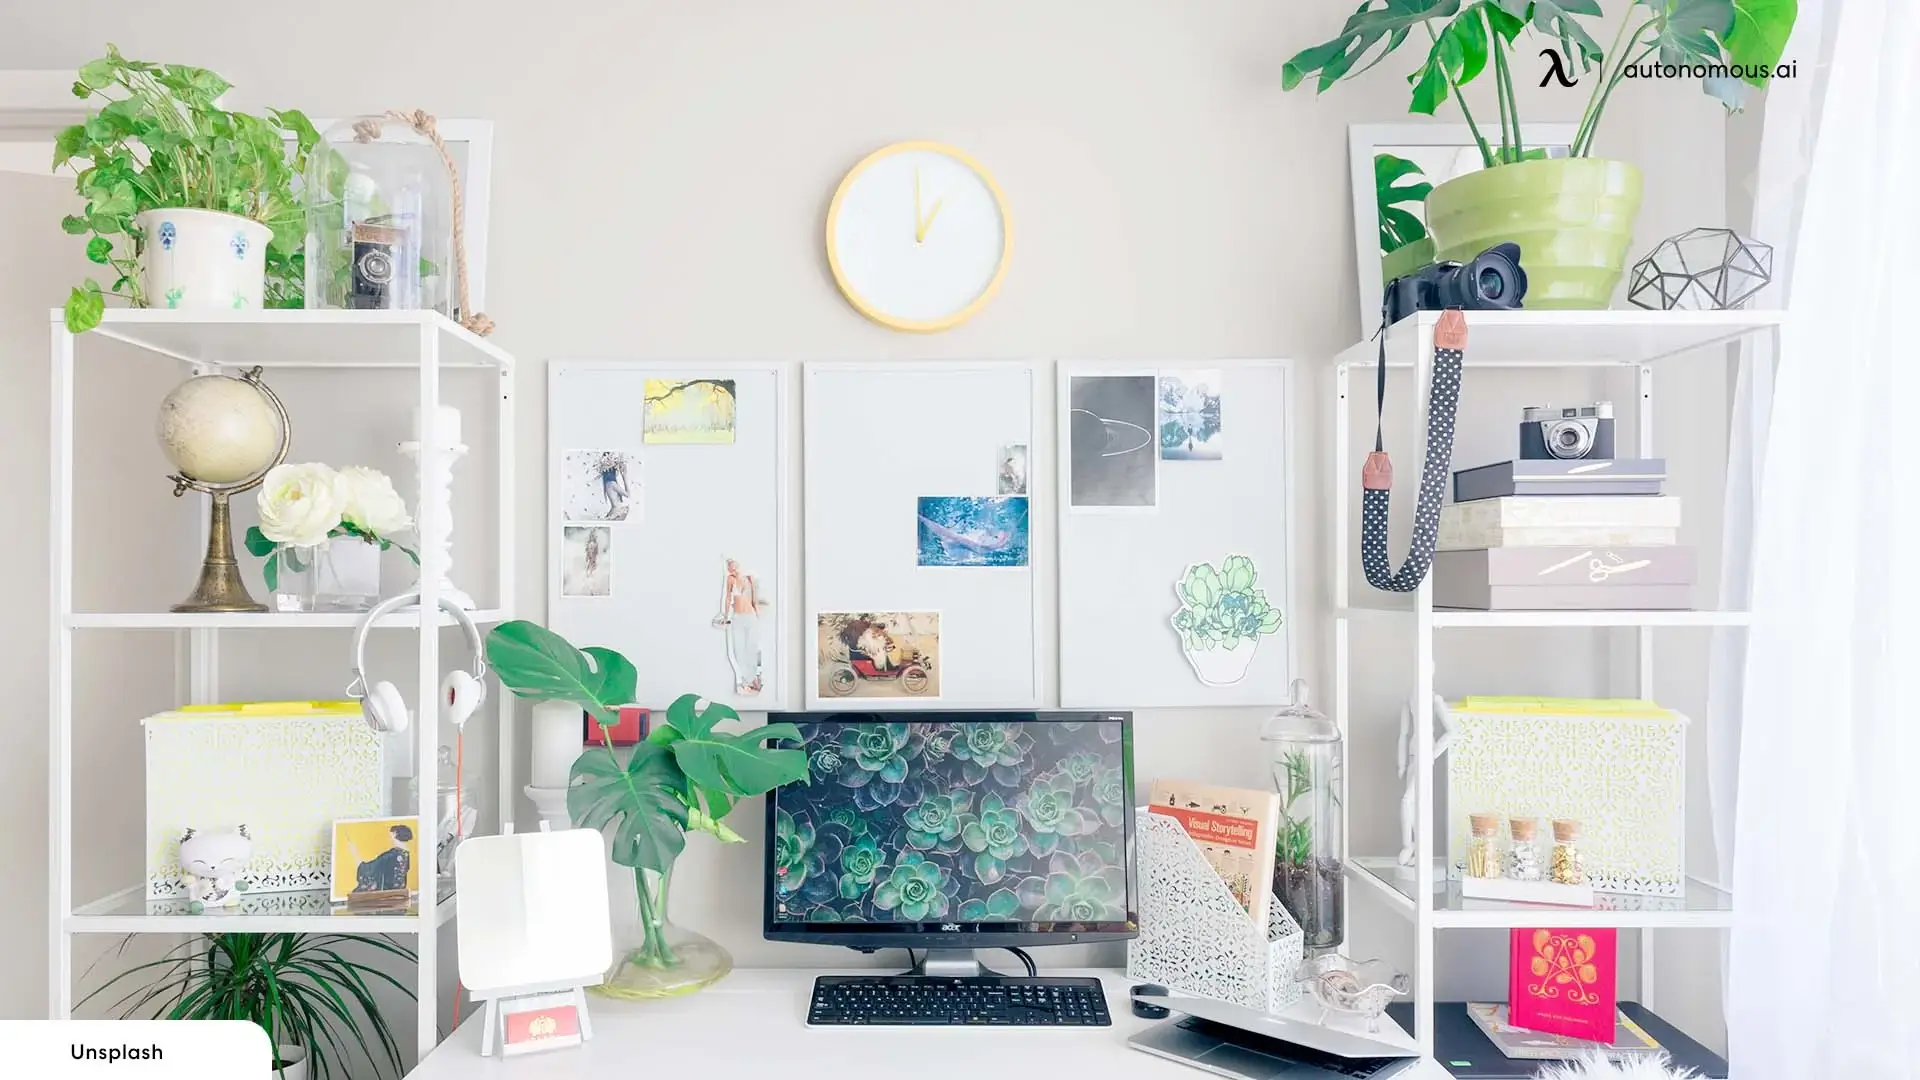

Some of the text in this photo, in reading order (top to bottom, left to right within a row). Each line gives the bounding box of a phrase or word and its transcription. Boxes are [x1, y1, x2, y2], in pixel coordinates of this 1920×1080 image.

[1188, 816, 1210, 831] Visual
[1211, 820, 1253, 841] Storytelling
[941, 922, 961, 933] acer
